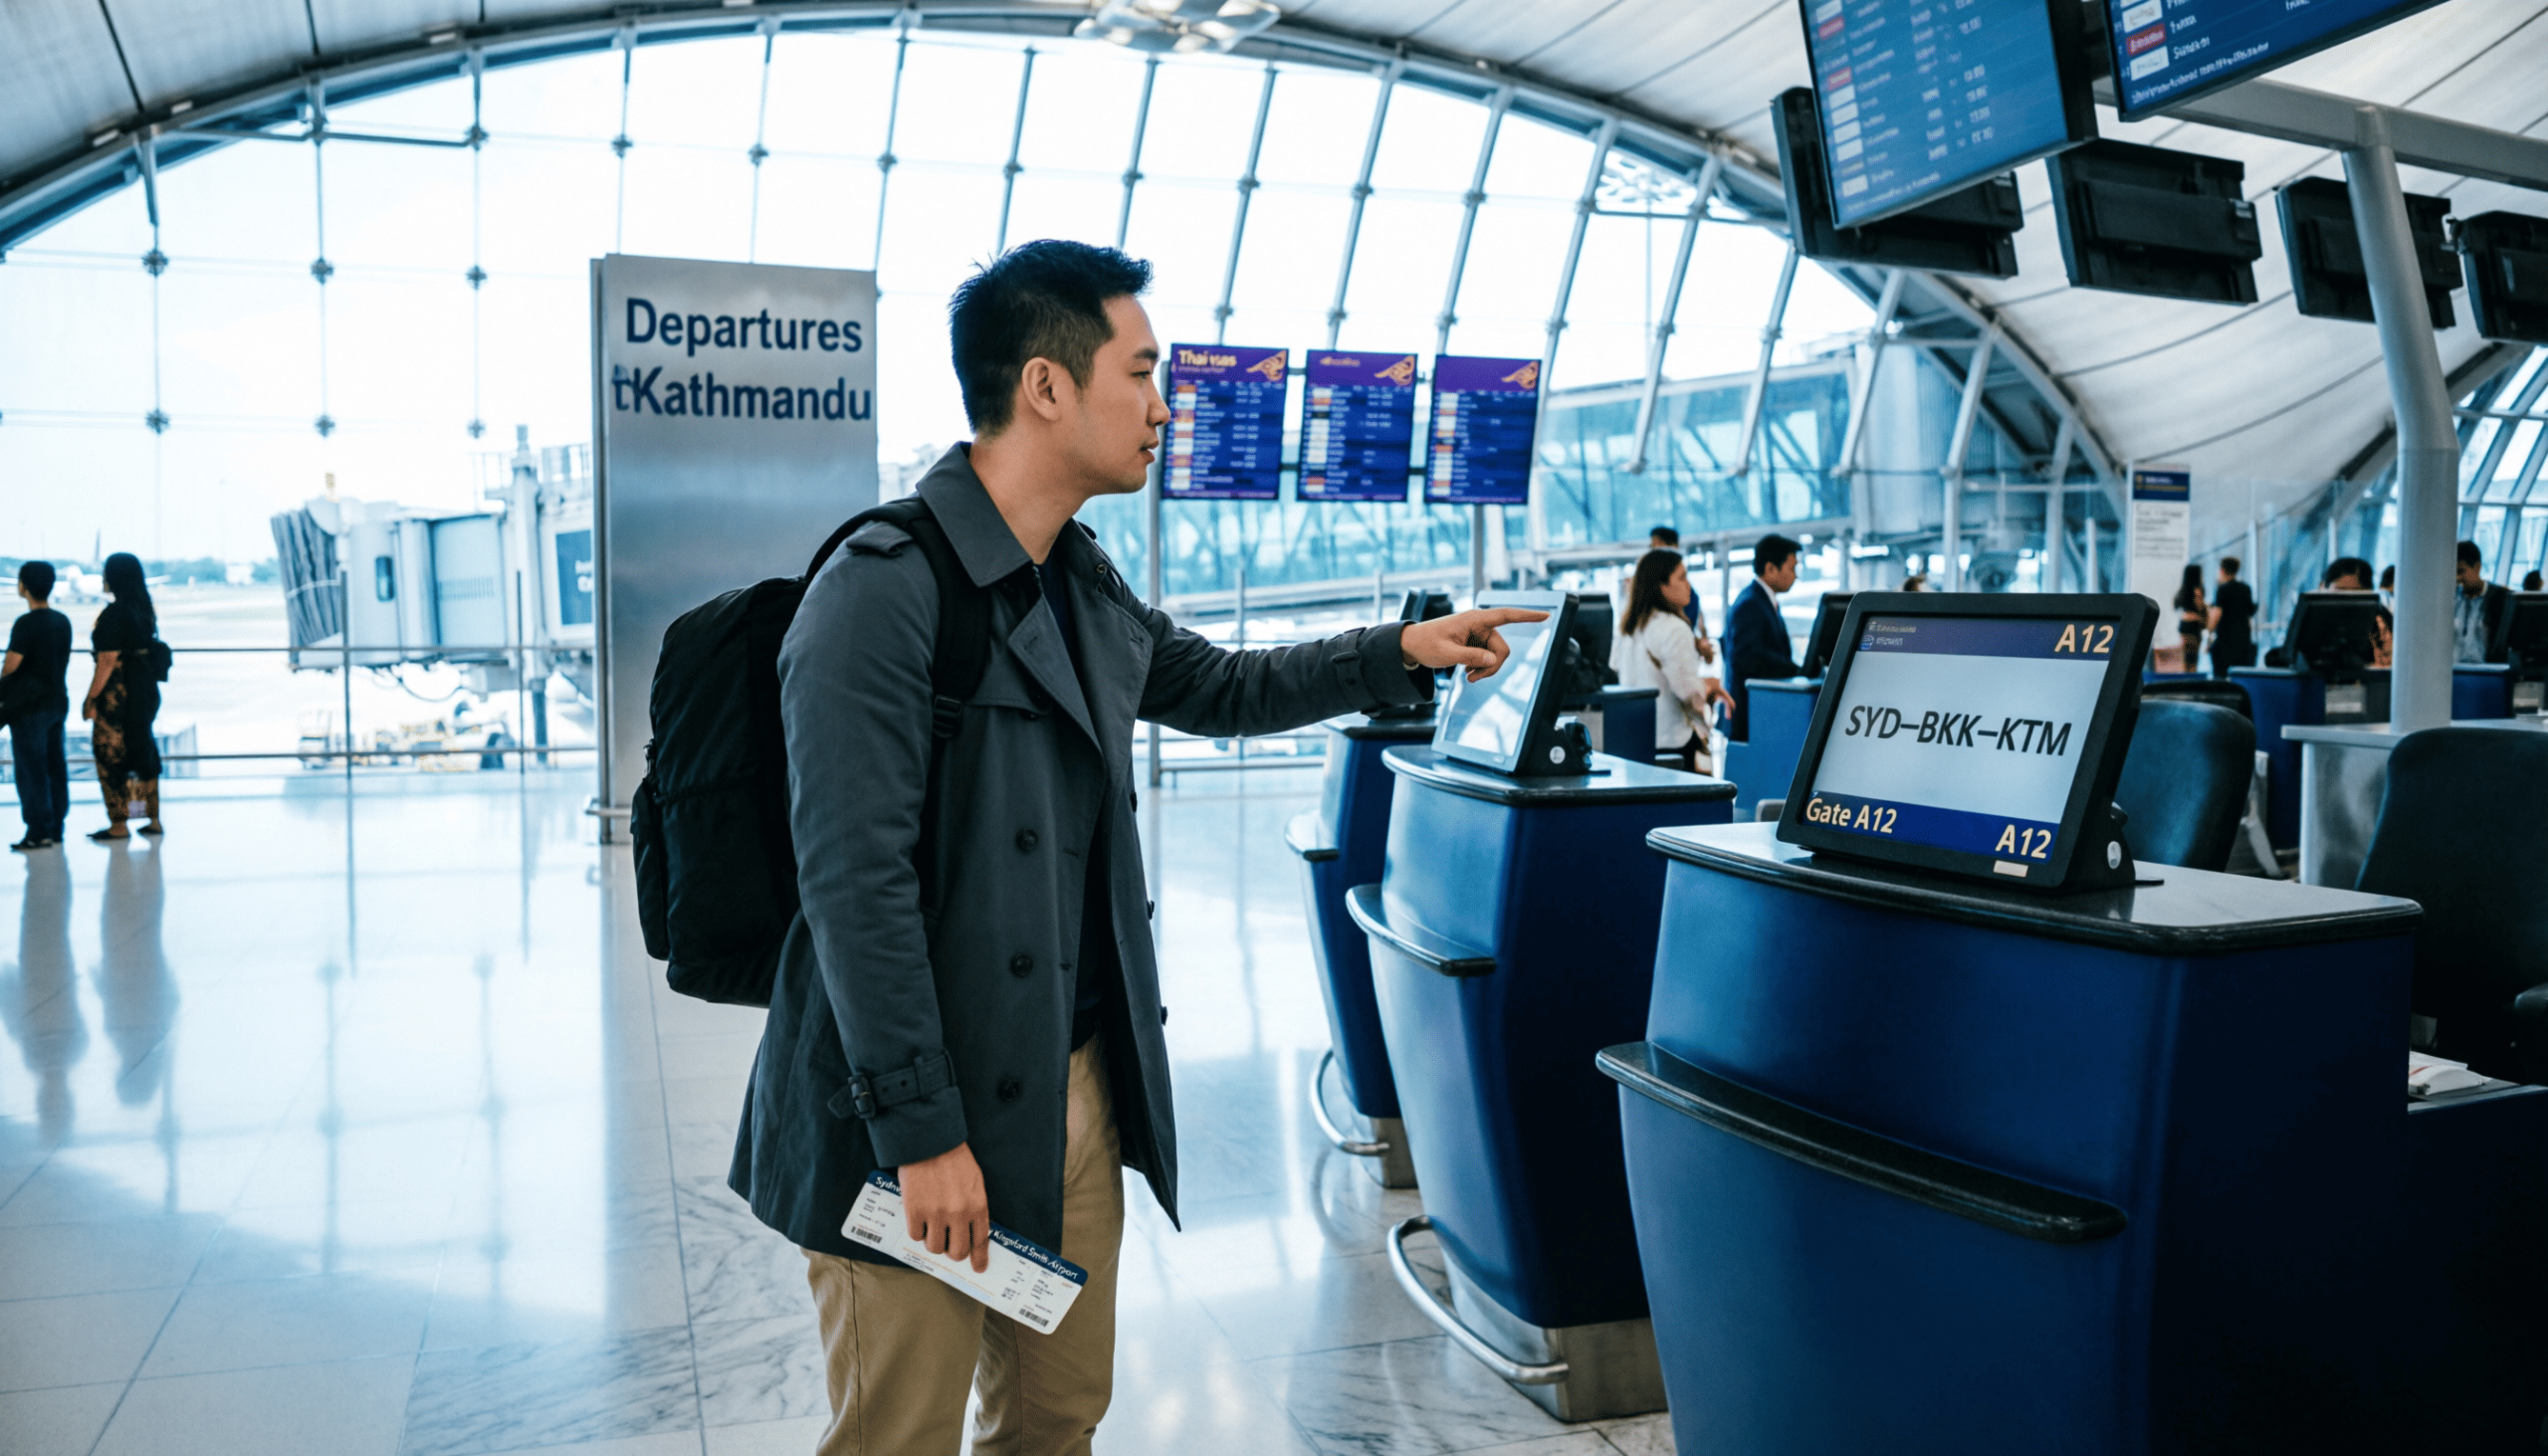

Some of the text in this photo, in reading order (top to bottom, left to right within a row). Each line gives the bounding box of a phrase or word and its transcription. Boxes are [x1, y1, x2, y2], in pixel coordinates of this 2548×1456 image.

[626, 297, 863, 357] Departures
[2053, 624, 2115, 654] A12
[1805, 797, 1898, 834] Gate A12
[1995, 824, 2052, 860] A12
